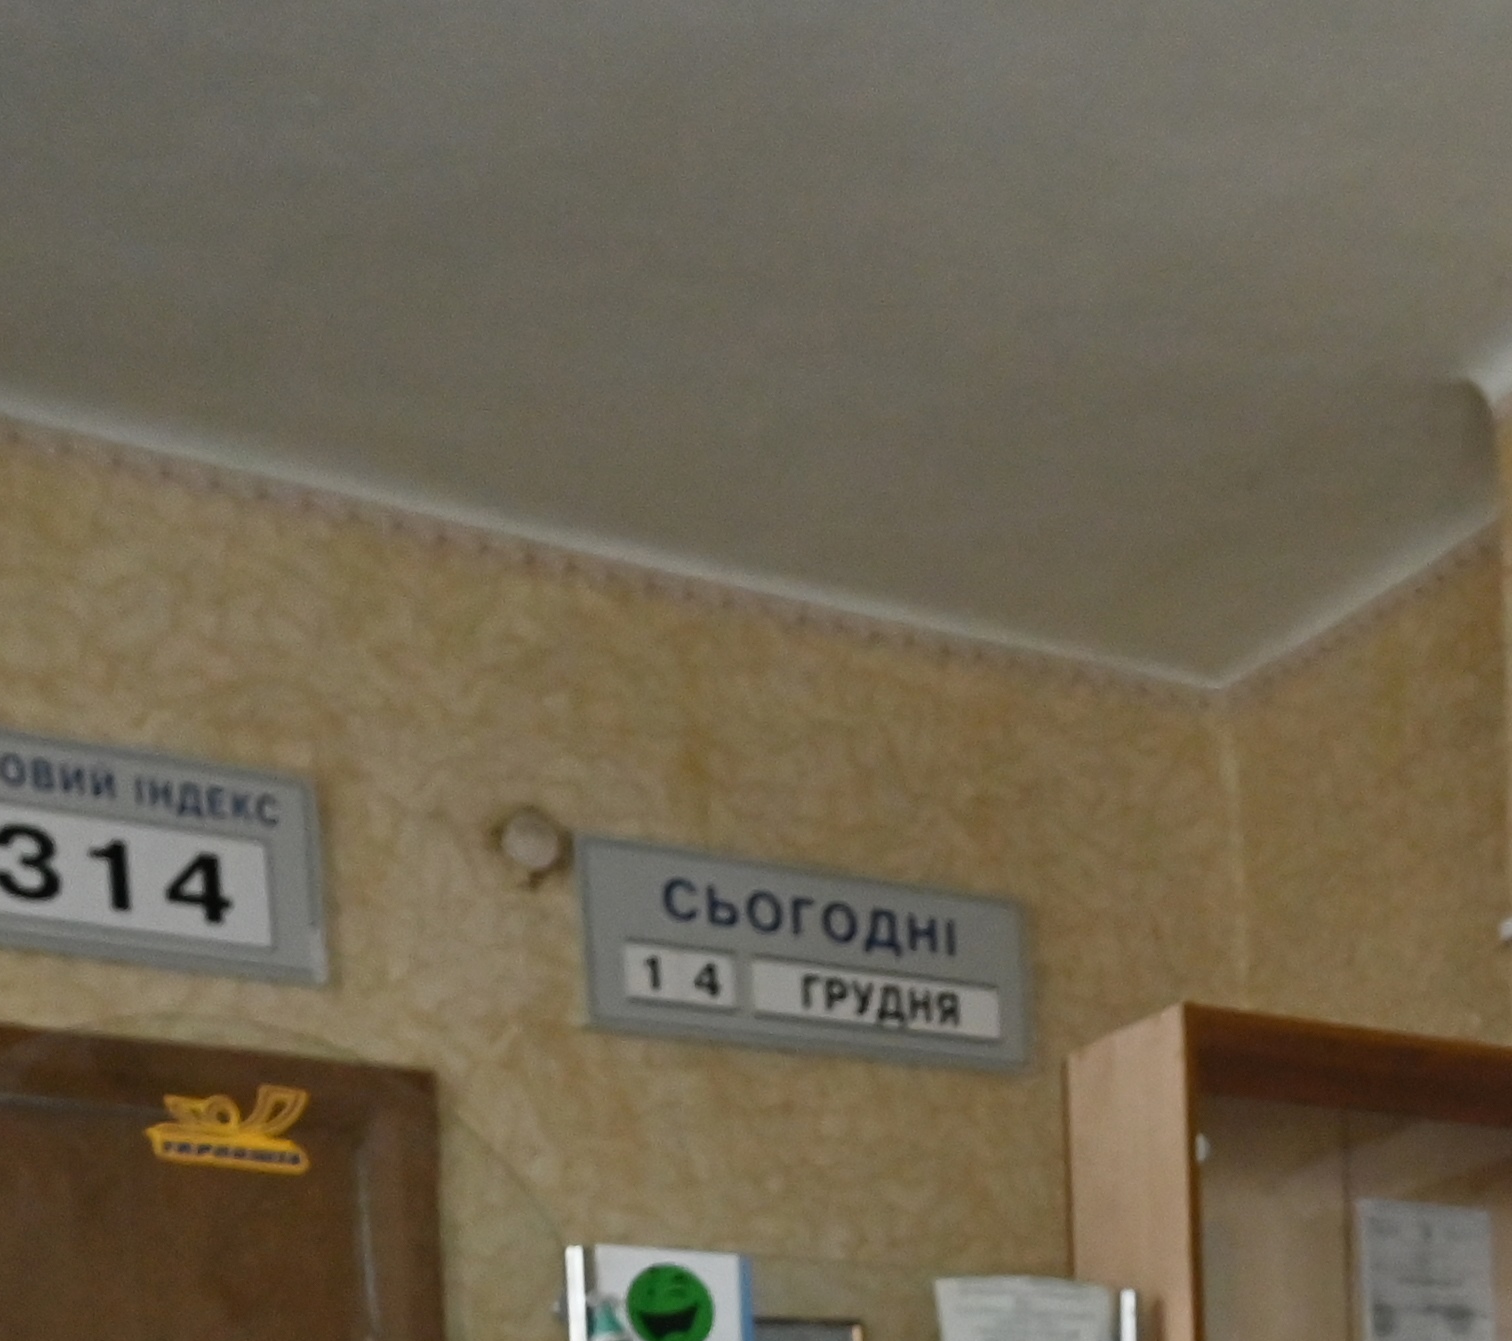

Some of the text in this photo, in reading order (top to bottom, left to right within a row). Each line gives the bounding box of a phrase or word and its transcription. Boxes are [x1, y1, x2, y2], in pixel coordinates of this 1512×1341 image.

[135, 777, 280, 827] ІНДЕКС
[662, 877, 957, 958] СЬОГОДНІ
[800, 973, 962, 1029] ГРУДНЯ
